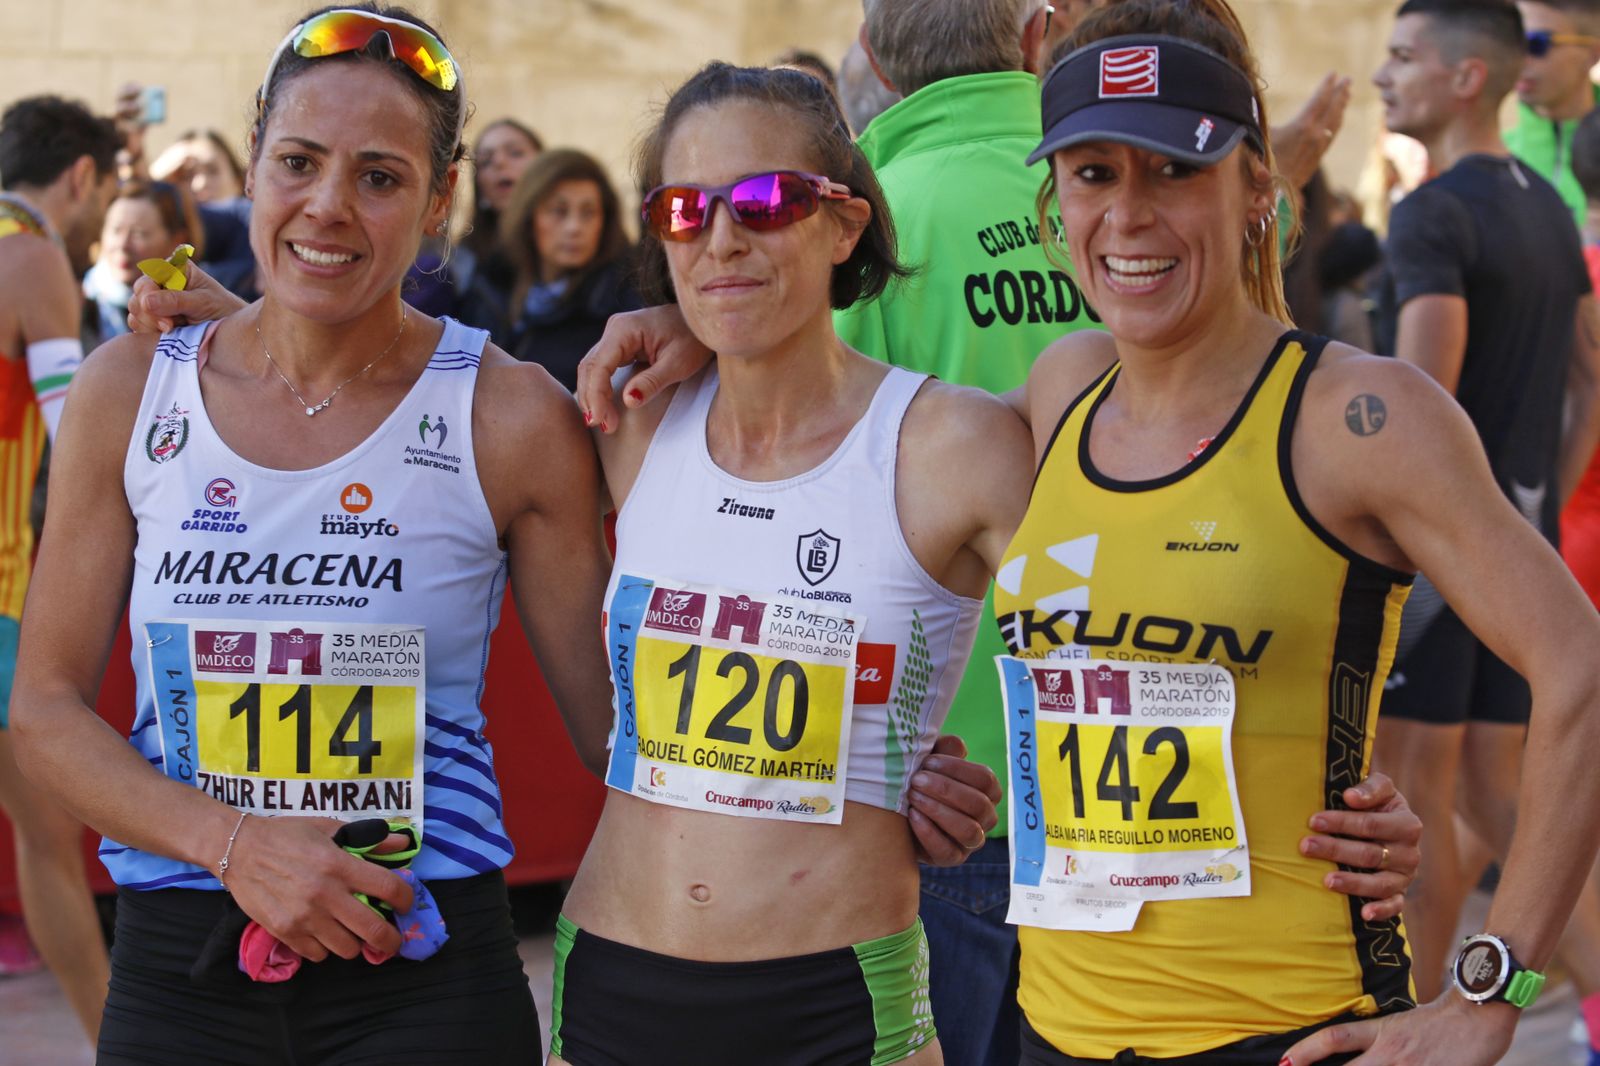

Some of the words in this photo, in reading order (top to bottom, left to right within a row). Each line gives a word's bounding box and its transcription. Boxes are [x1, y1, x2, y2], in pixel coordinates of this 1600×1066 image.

[977, 220, 1026, 258] CLUB
[404, 445, 462, 464] Ayuntamiento
[403, 457, 413, 465] de
[413, 456, 461, 475] Maracena
[191, 508, 240, 521] SPORT
[321, 513, 359, 523] grupo
[717, 497, 775, 520] Zirauna
[180, 519, 248, 534] GARRIDO
[319, 517, 400, 539] mayfo
[1165, 541, 1240, 552] EKUON
[153, 550, 403, 592] MARACENA
[173, 593, 221, 605] CLUB
[226, 593, 254, 605] DE
[256, 593, 369, 608] ATLETISMO
[801, 589, 852, 603] LaBlanca
[736, 601, 750, 611] 35
[646, 610, 701, 630] IMDECO
[773, 604, 793, 619] 35
[797, 610, 855, 633] MEDIA
[618, 623, 632, 634] 1
[769, 621, 854, 646] MARATÓN
[996, 609, 1273, 664] EKUON
[290, 635, 304, 644] 35
[332, 634, 355, 647] 35
[361, 634, 420, 648] MEDIA
[767, 638, 823, 656] CÓRDOBA
[823, 646, 851, 659] 2019
[197, 654, 254, 667] IMDECO
[331, 648, 420, 665] MARATÓN
[166, 669, 182, 680] 1
[331, 666, 391, 678] CÓRDOBA
[392, 667, 420, 678] 2019
[1098, 671, 1113, 681] 35
[1139, 671, 1161, 684] 35
[1166, 671, 1229, 686] MEDIA
[617, 644, 636, 738] CAJÓN
[667, 644, 809, 752] 120
[1140, 685, 1231, 703] MARATÓN
[1019, 708, 1030, 719] 1
[1141, 706, 1202, 717] CÓRDOBA
[1202, 707, 1230, 718] 2019
[169, 689, 192, 781] CAJÓN
[229, 683, 381, 774] 114
[693, 745, 756, 775] GÓMEZ
[760, 757, 835, 782] MARTÍN
[1058, 723, 1199, 821] 142
[1017, 731, 1038, 830] CAJÓN
[263, 780, 293, 810] EL
[705, 790, 773, 811] Cruzcampo
[777, 800, 818, 815] Radler
[1045, 824, 1064, 838] ALBA
[1099, 828, 1164, 845] REGUILLO
[1168, 826, 1234, 843] MORENO
[1110, 873, 1179, 888] Cruzcampo
[1182, 870, 1223, 886] Radler
